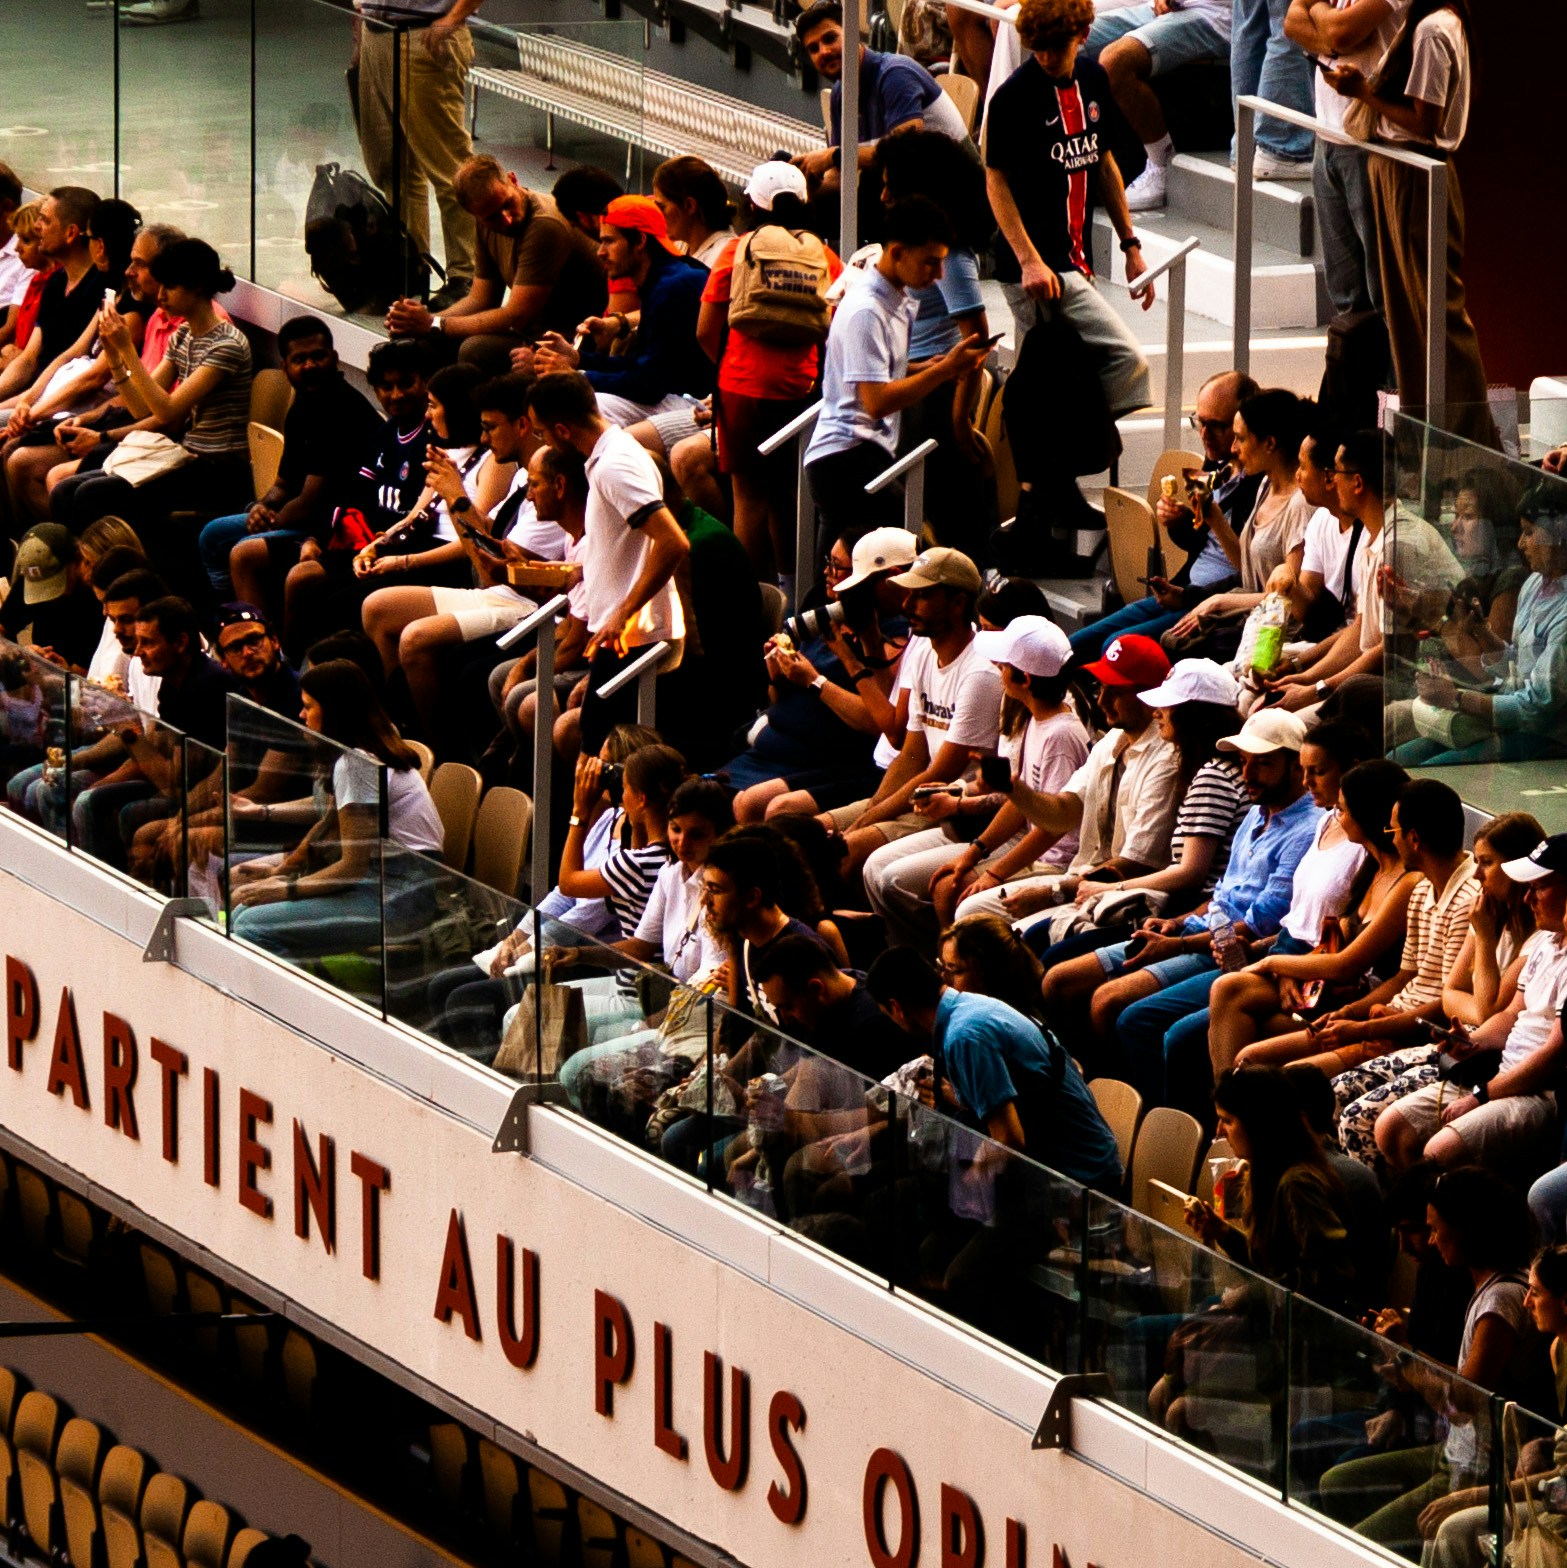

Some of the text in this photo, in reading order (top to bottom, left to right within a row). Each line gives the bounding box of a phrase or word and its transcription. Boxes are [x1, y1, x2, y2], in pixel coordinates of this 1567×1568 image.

[1050, 132, 1099, 164] QATAR
[433, 1207, 541, 1372] AU
[594, 1287, 809, 1529] PLUS
